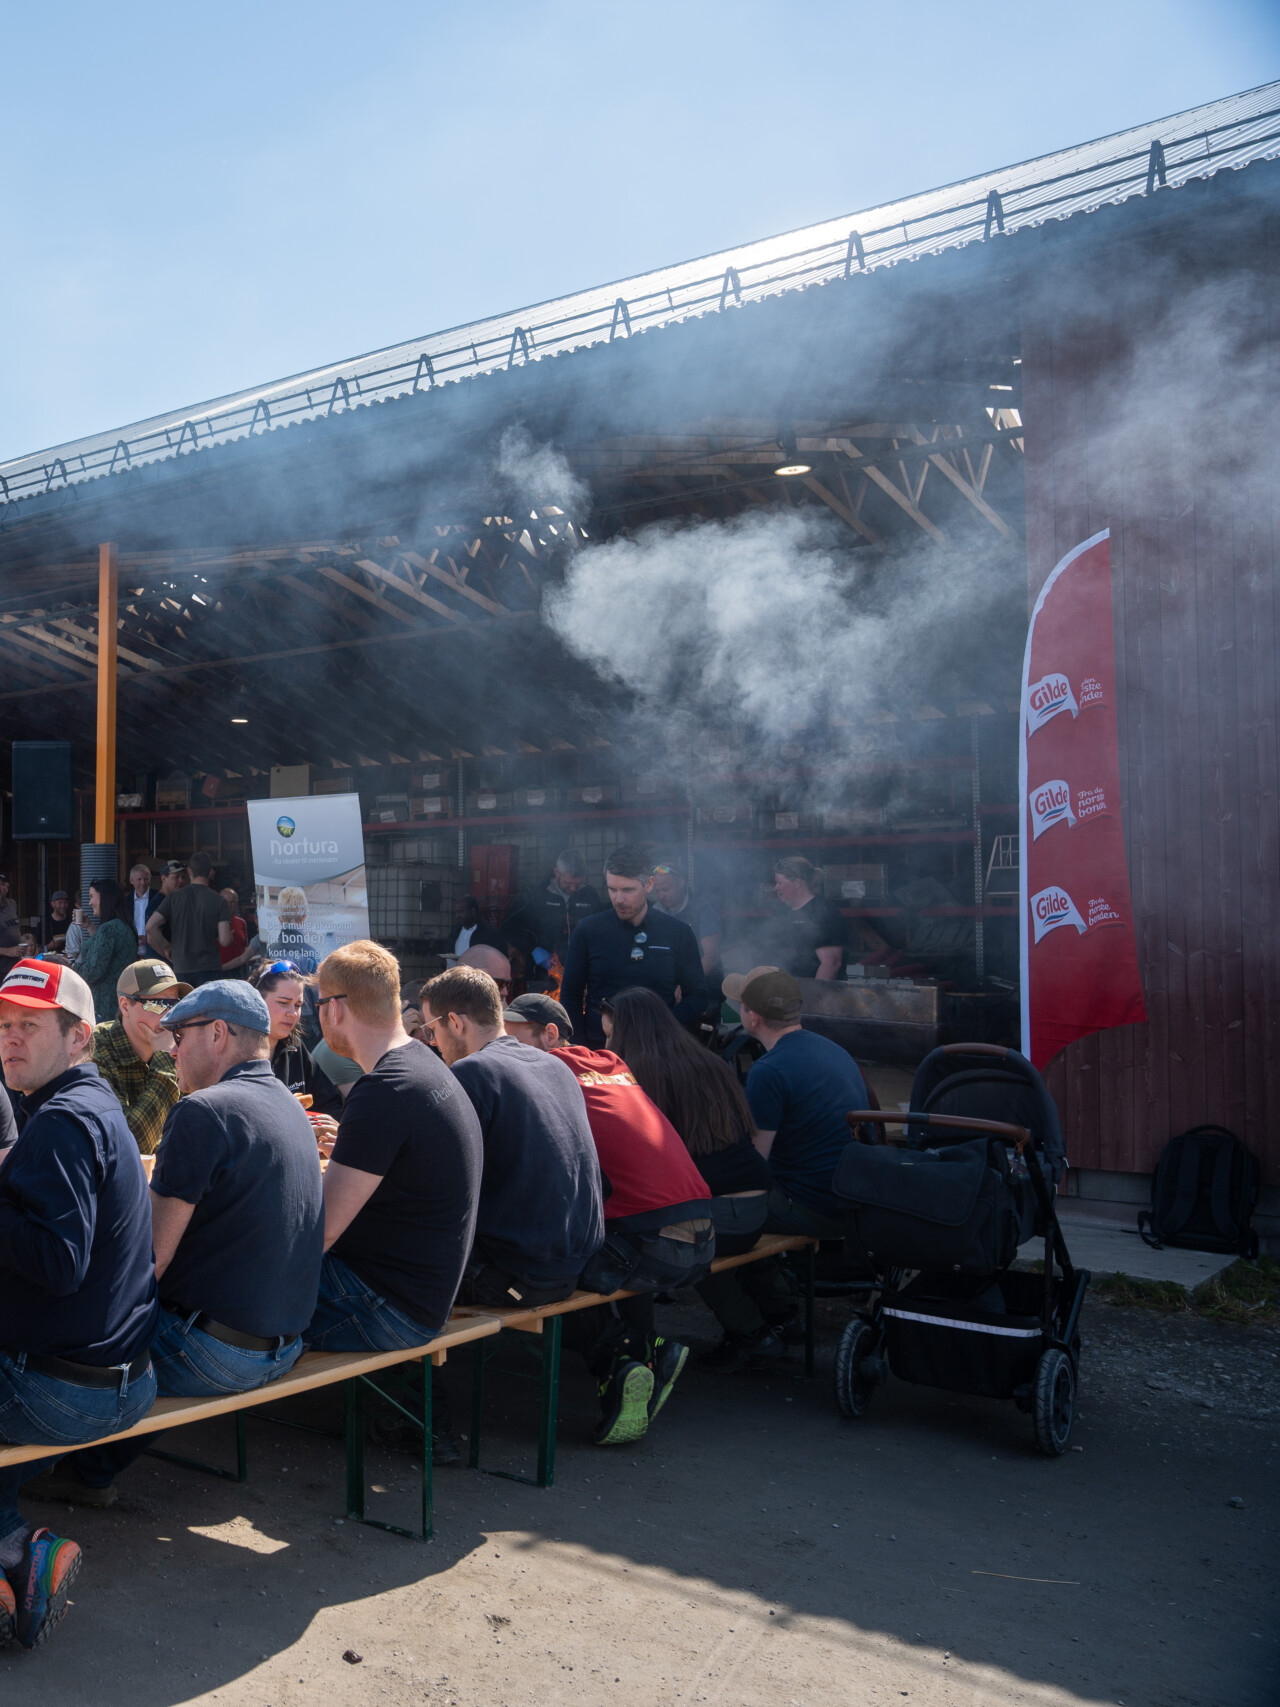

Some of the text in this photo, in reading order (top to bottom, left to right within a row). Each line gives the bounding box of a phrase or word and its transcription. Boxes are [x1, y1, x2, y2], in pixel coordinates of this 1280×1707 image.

[1030, 679, 1068, 711] Gilde
[1034, 785, 1068, 816] Gilde
[270, 837, 339, 856] nortura
[1036, 892, 1070, 920] Gilde
[267, 920, 354, 932] Best mulig økonomi
[267, 933, 279, 943] for
[282, 932, 325, 944] bonden
[268, 948, 287, 957] kort
[288, 950, 299, 959] og
